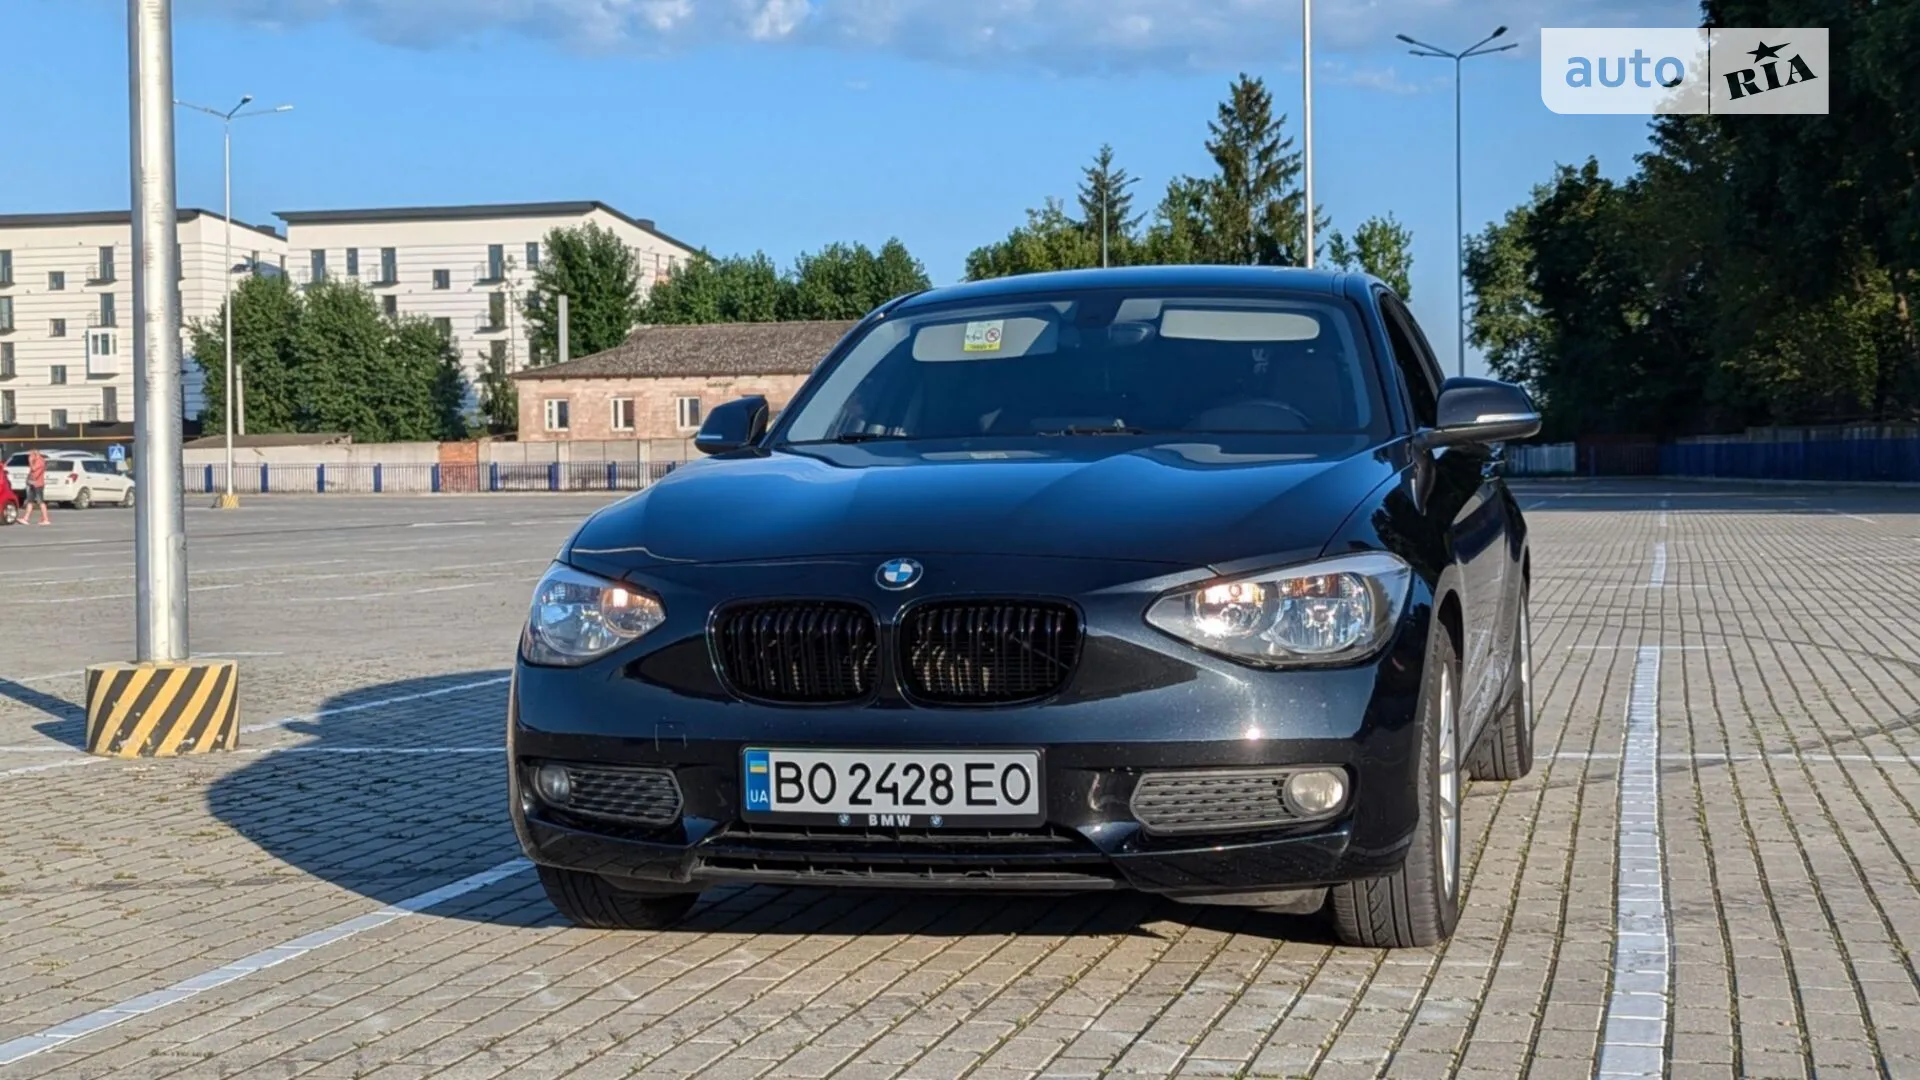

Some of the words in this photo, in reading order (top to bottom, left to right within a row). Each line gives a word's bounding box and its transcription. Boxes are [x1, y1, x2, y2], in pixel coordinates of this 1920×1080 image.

[774, 761, 838, 805] BO
[848, 762, 955, 807] 2428
[964, 762, 1031, 807] EO
[750, 789, 769, 804] UA
[868, 814, 912, 828] BMW
